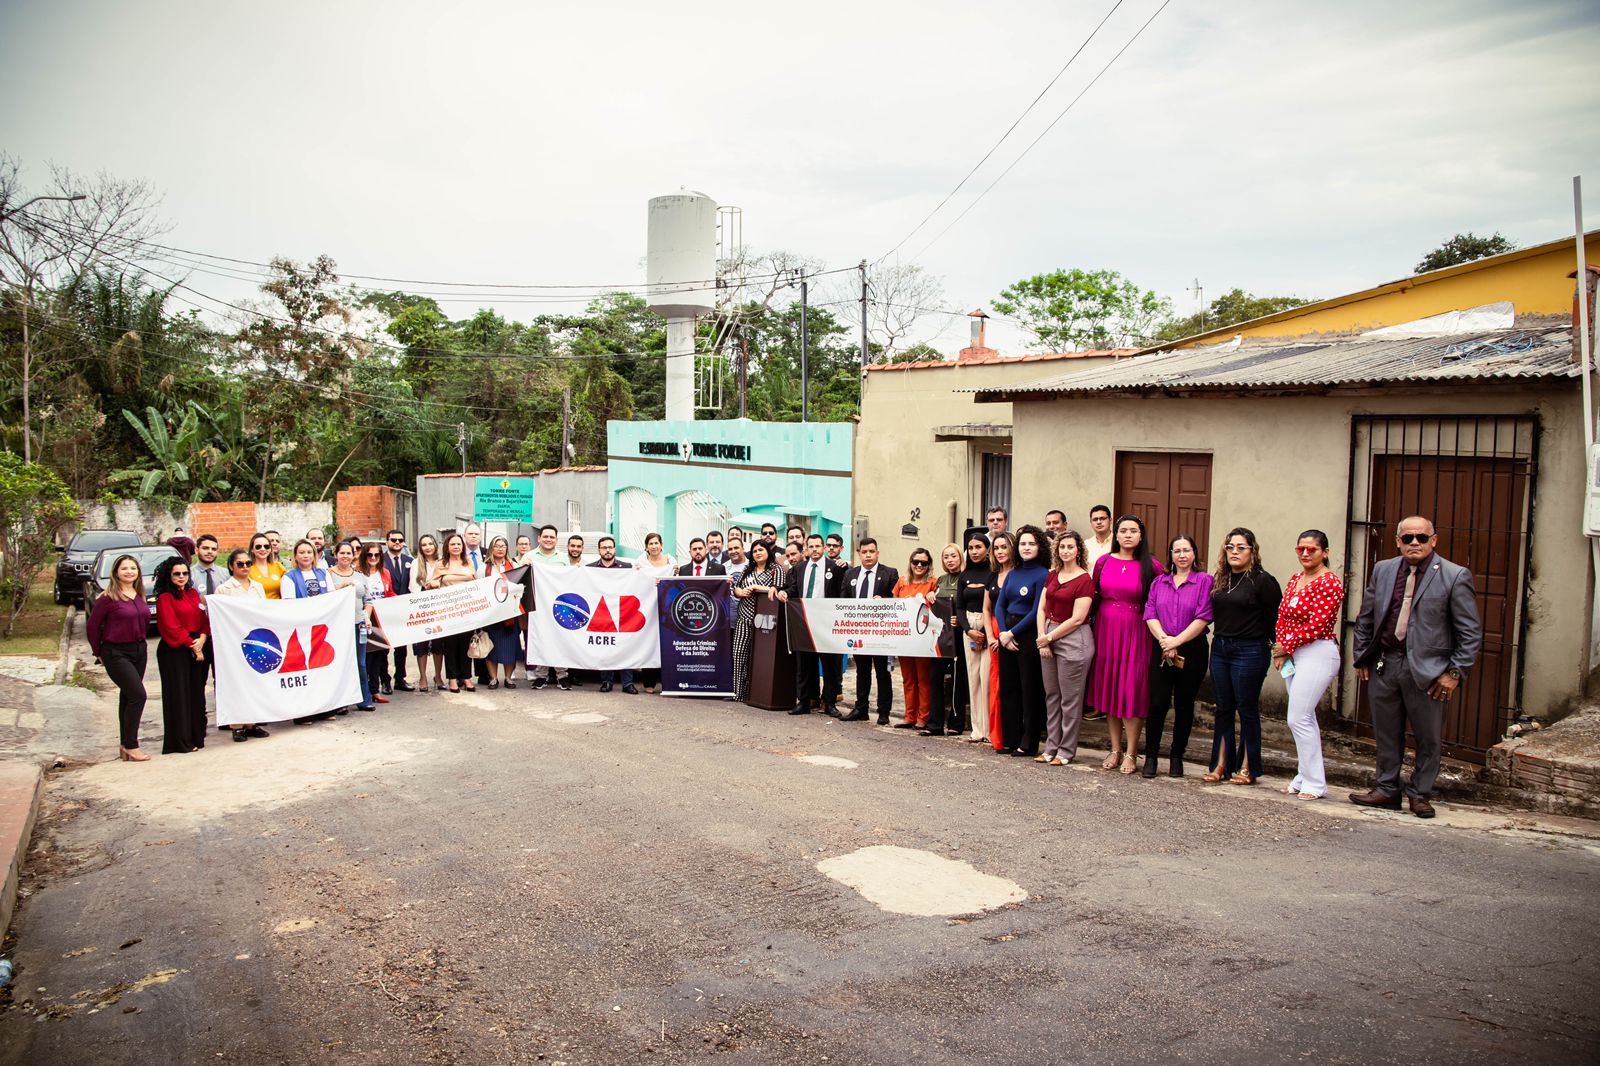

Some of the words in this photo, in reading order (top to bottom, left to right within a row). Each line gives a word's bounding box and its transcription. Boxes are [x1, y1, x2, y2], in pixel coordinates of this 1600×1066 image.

[718, 444, 745, 460] FORTE
[910, 507, 920, 521] 22
[409, 596, 429, 604] Somos
[419, 602, 430, 610] não
[857, 602, 906, 612] Advogados(as),
[406, 616, 434, 627] merece
[448, 602, 491, 619] respeitada!
[416, 605, 454, 619] Advocacia
[455, 596, 488, 610] Criminal
[553, 593, 646, 632] OAB
[872, 629, 911, 637] respeitada!
[588, 636, 616, 645] ACRE
[241, 624, 335, 674] OAB
[280, 675, 308, 689] ACRE
